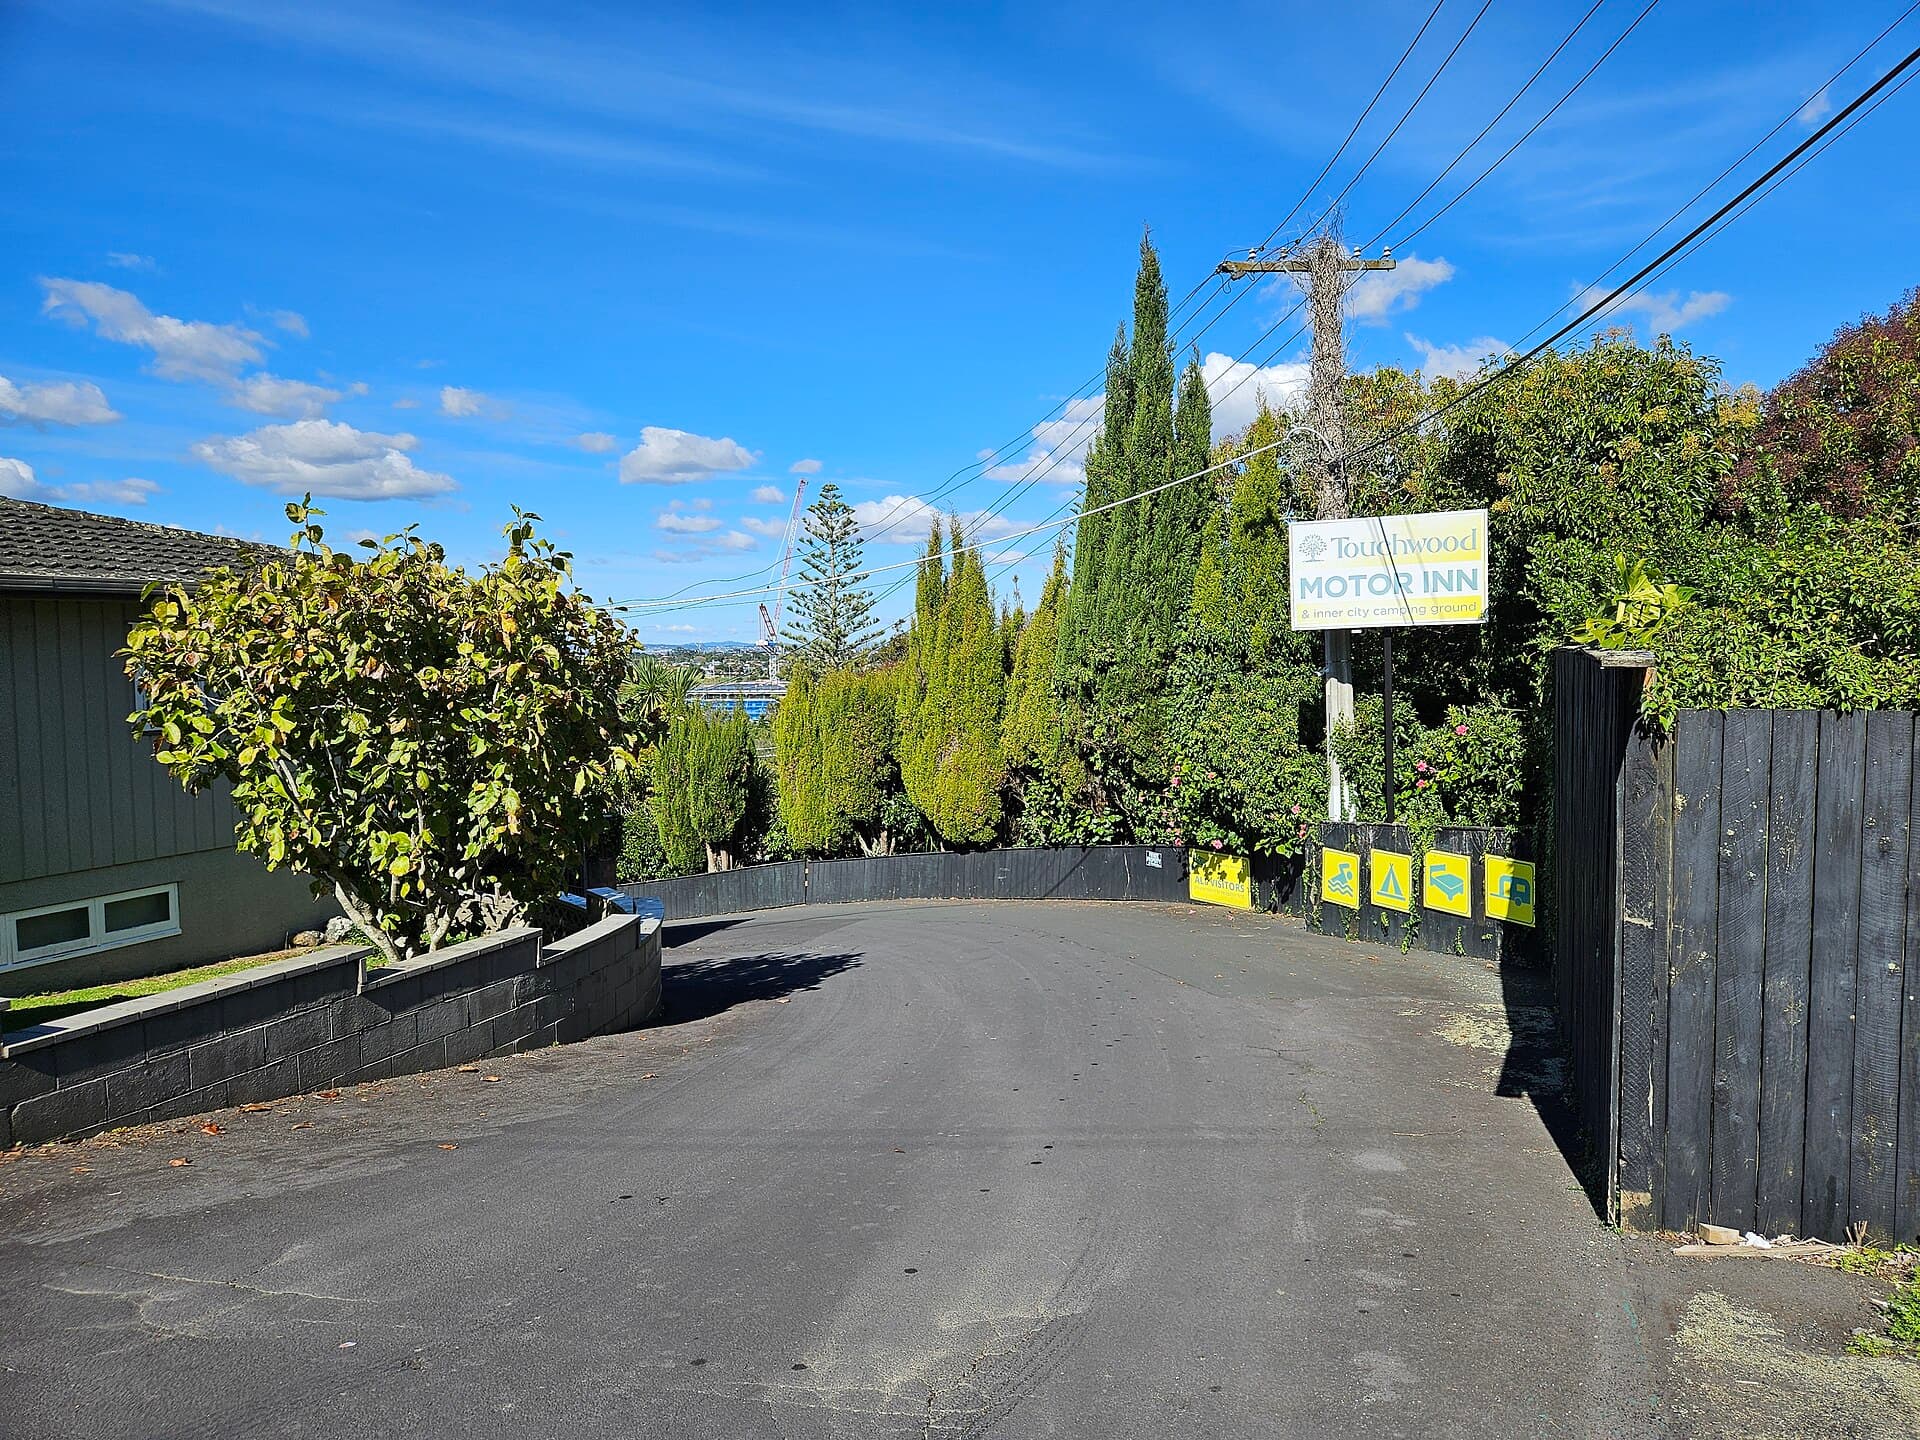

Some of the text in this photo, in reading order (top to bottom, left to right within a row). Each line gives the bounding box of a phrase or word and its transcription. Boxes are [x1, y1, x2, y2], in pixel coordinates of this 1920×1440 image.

[1330, 528, 1477, 559] Touchwood
[1300, 568, 1478, 599] MOTOR INN
[1301, 601, 1477, 620] & inner city campng ground
[1210, 879, 1245, 893] VISITORS
